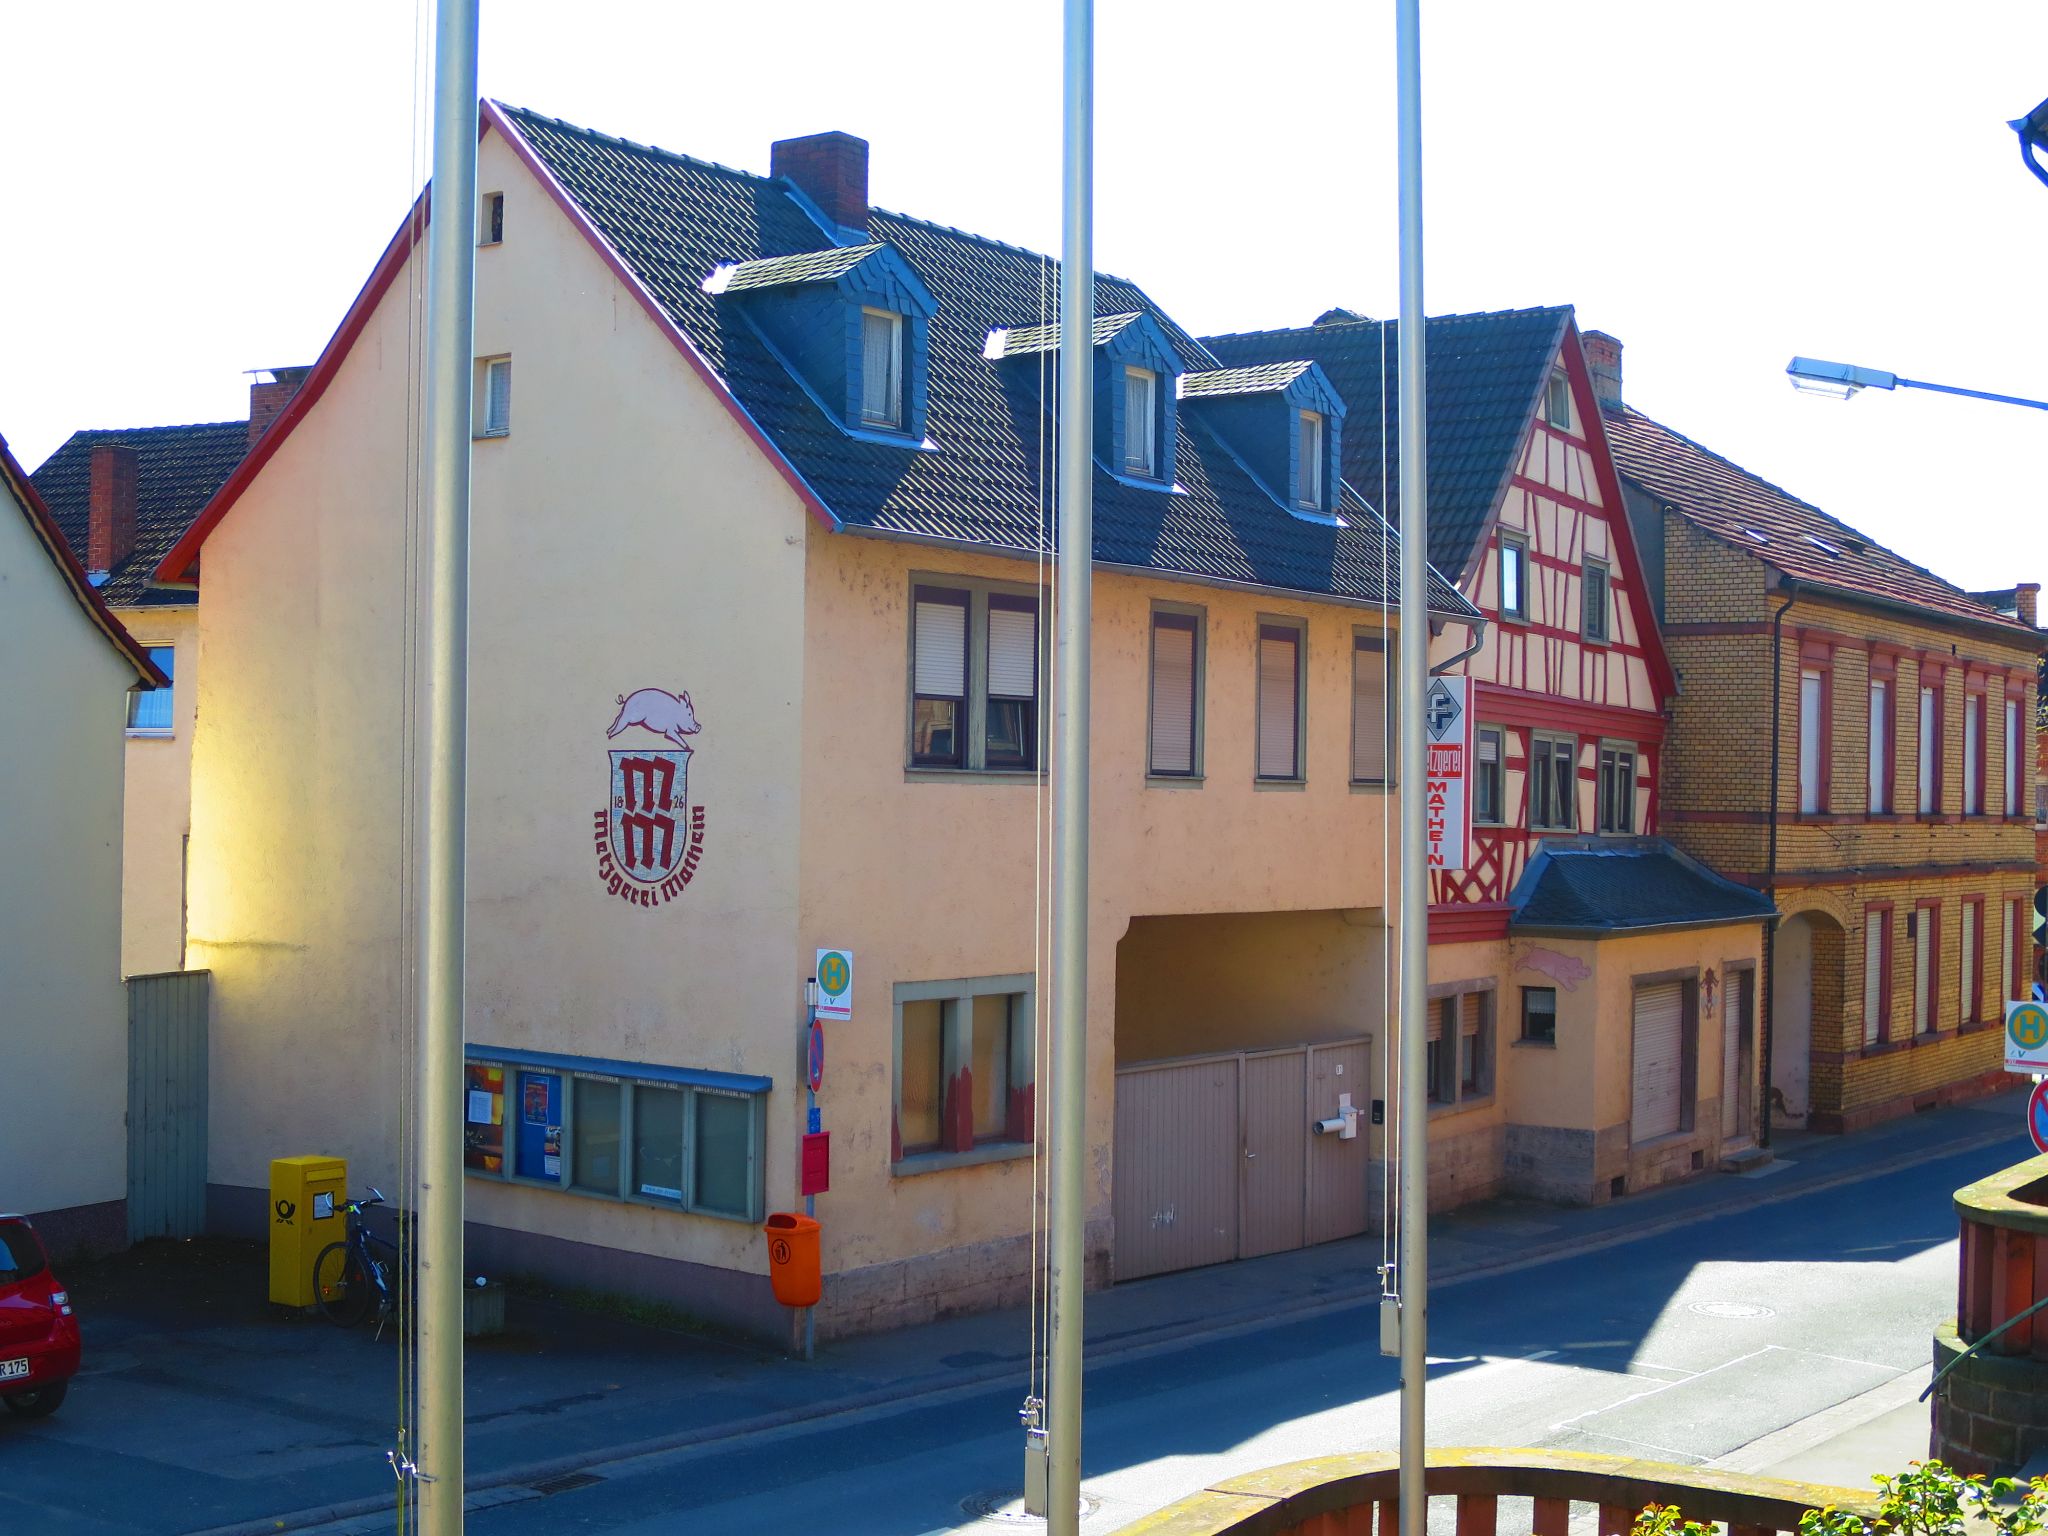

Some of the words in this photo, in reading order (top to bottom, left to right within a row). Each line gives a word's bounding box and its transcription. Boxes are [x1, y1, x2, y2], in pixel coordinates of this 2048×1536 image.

[614, 796, 624, 809] 18
[674, 795, 684, 809] 26
[1428, 782, 1447, 865] MATHEIN
[661, 805, 705, 902] Mathein
[826, 962, 841, 985] H
[2021, 1014, 2040, 1039] H
[8, 1360, 27, 1374] 175
